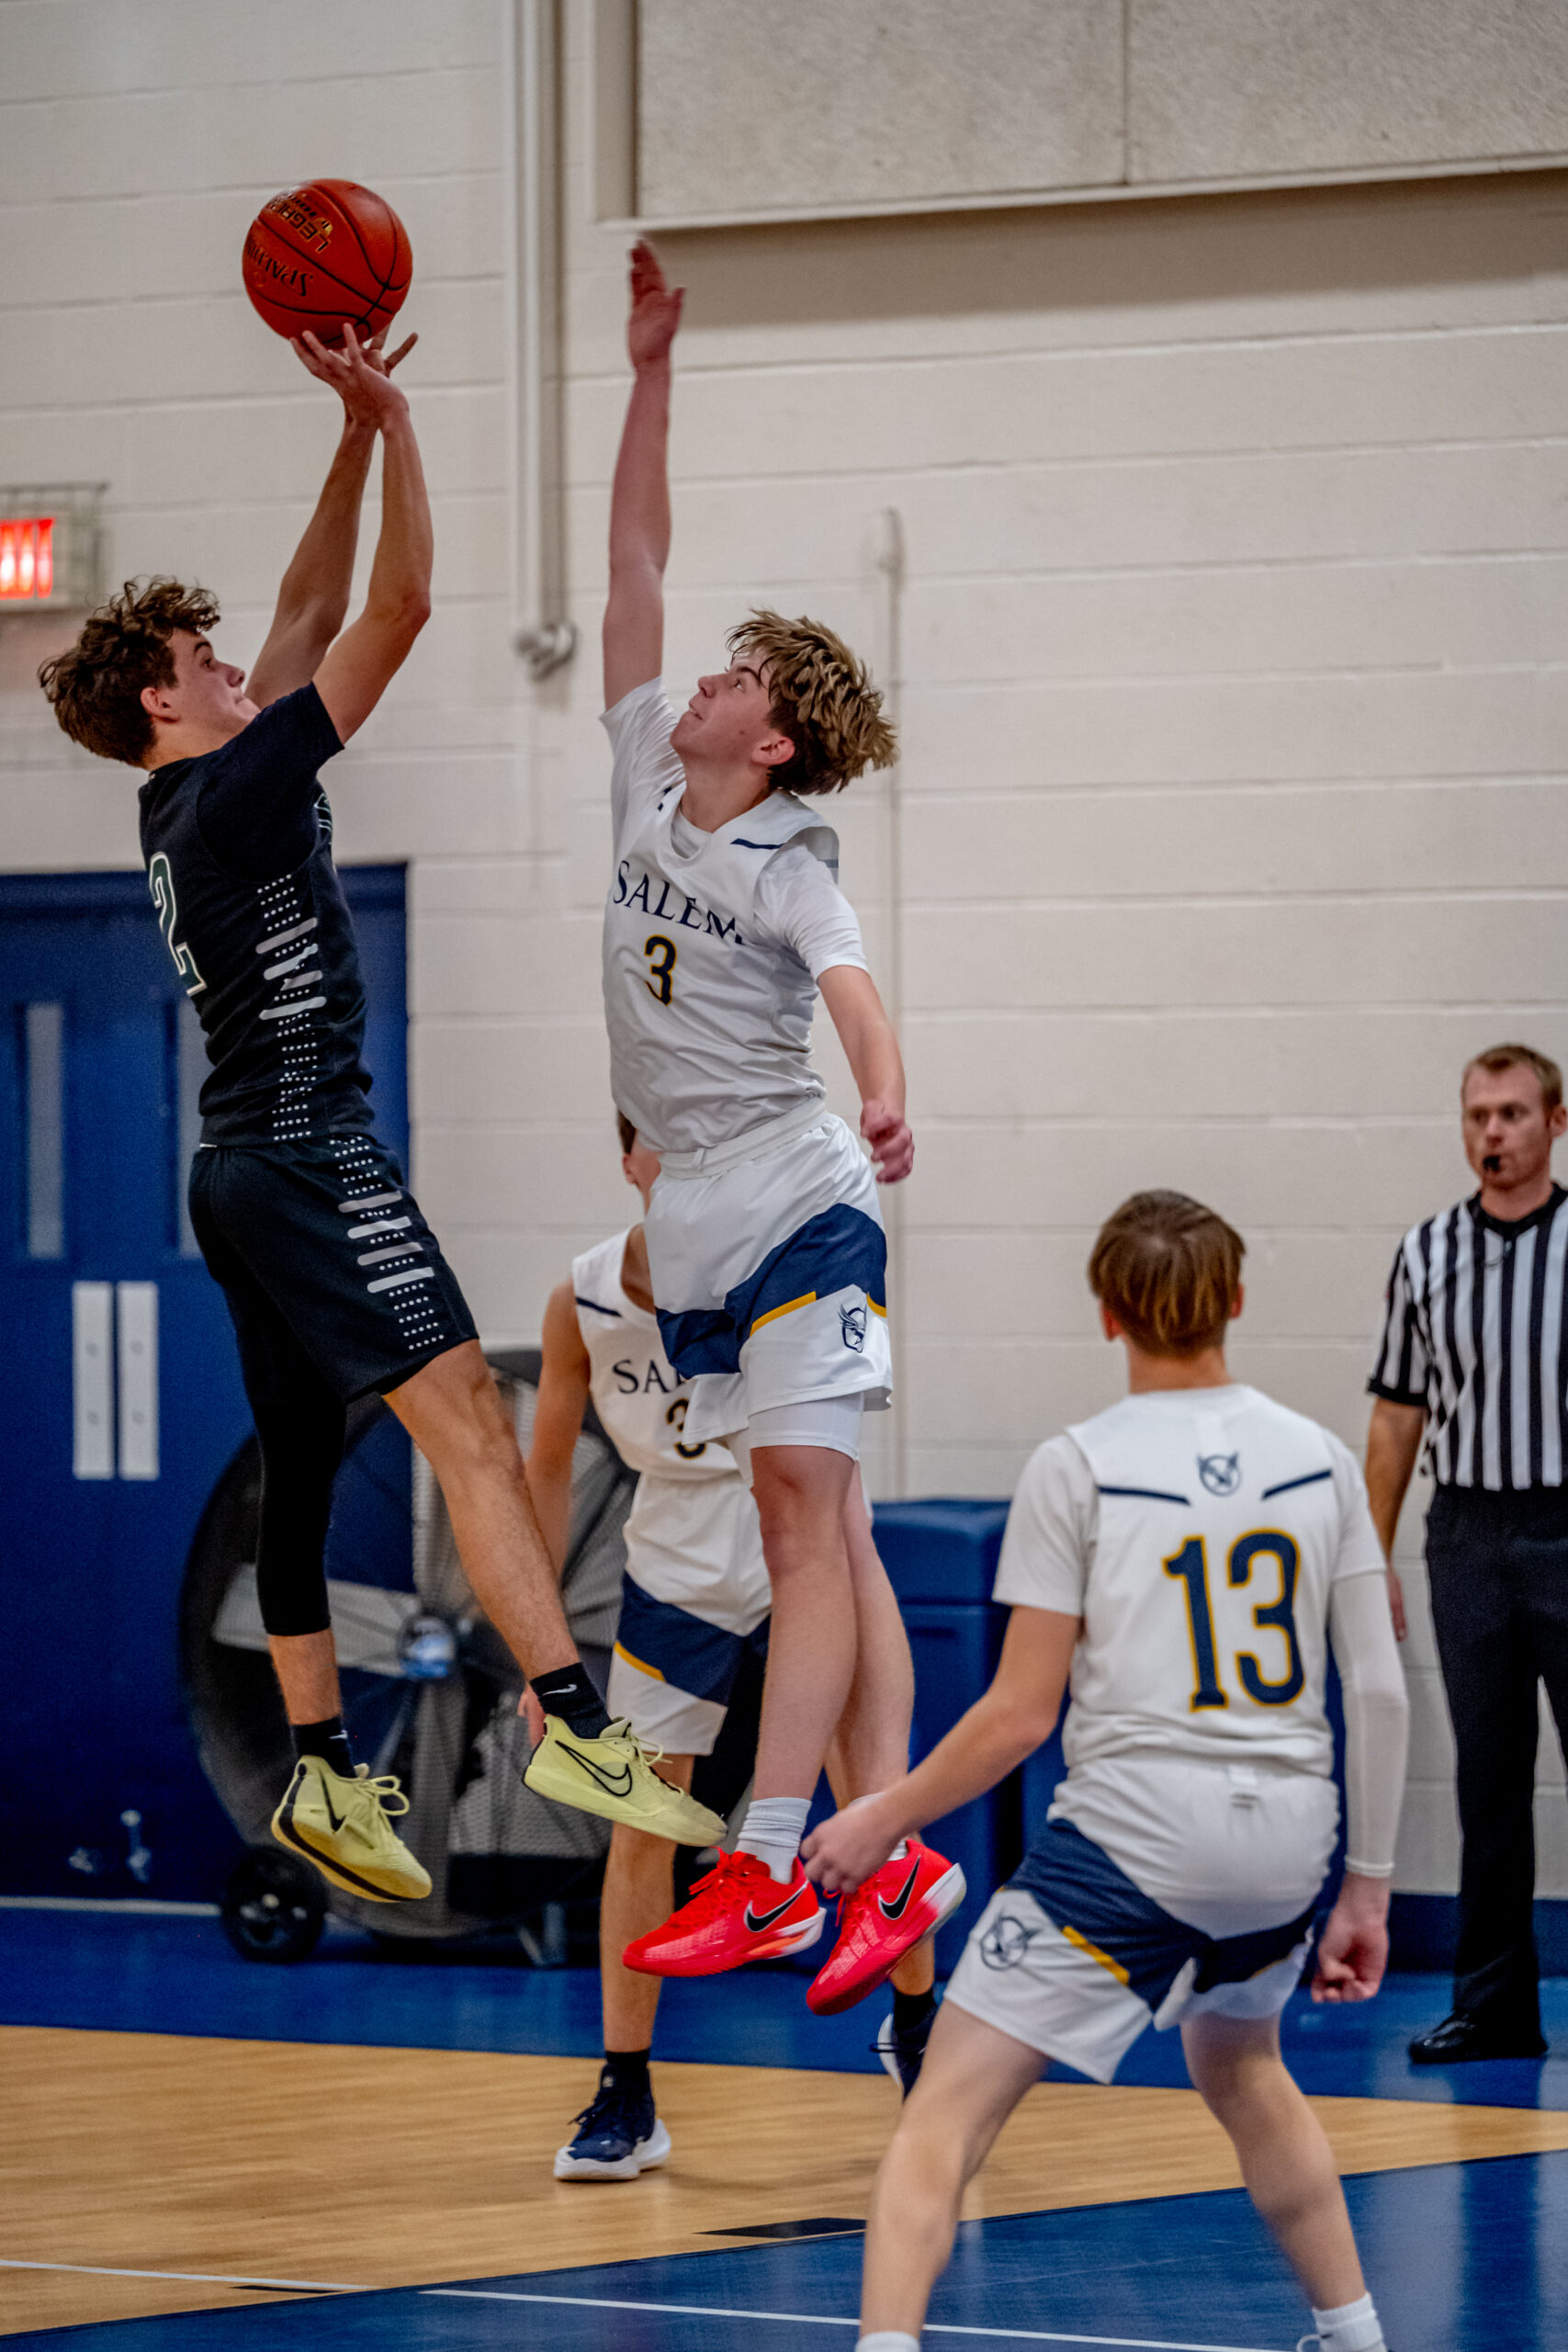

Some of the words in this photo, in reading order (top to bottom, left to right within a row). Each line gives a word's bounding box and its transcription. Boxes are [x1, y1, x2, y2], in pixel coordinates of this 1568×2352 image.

[150, 851, 208, 997] 2
[644, 933, 678, 1007] 3
[1161, 1528, 1306, 1713] 13
